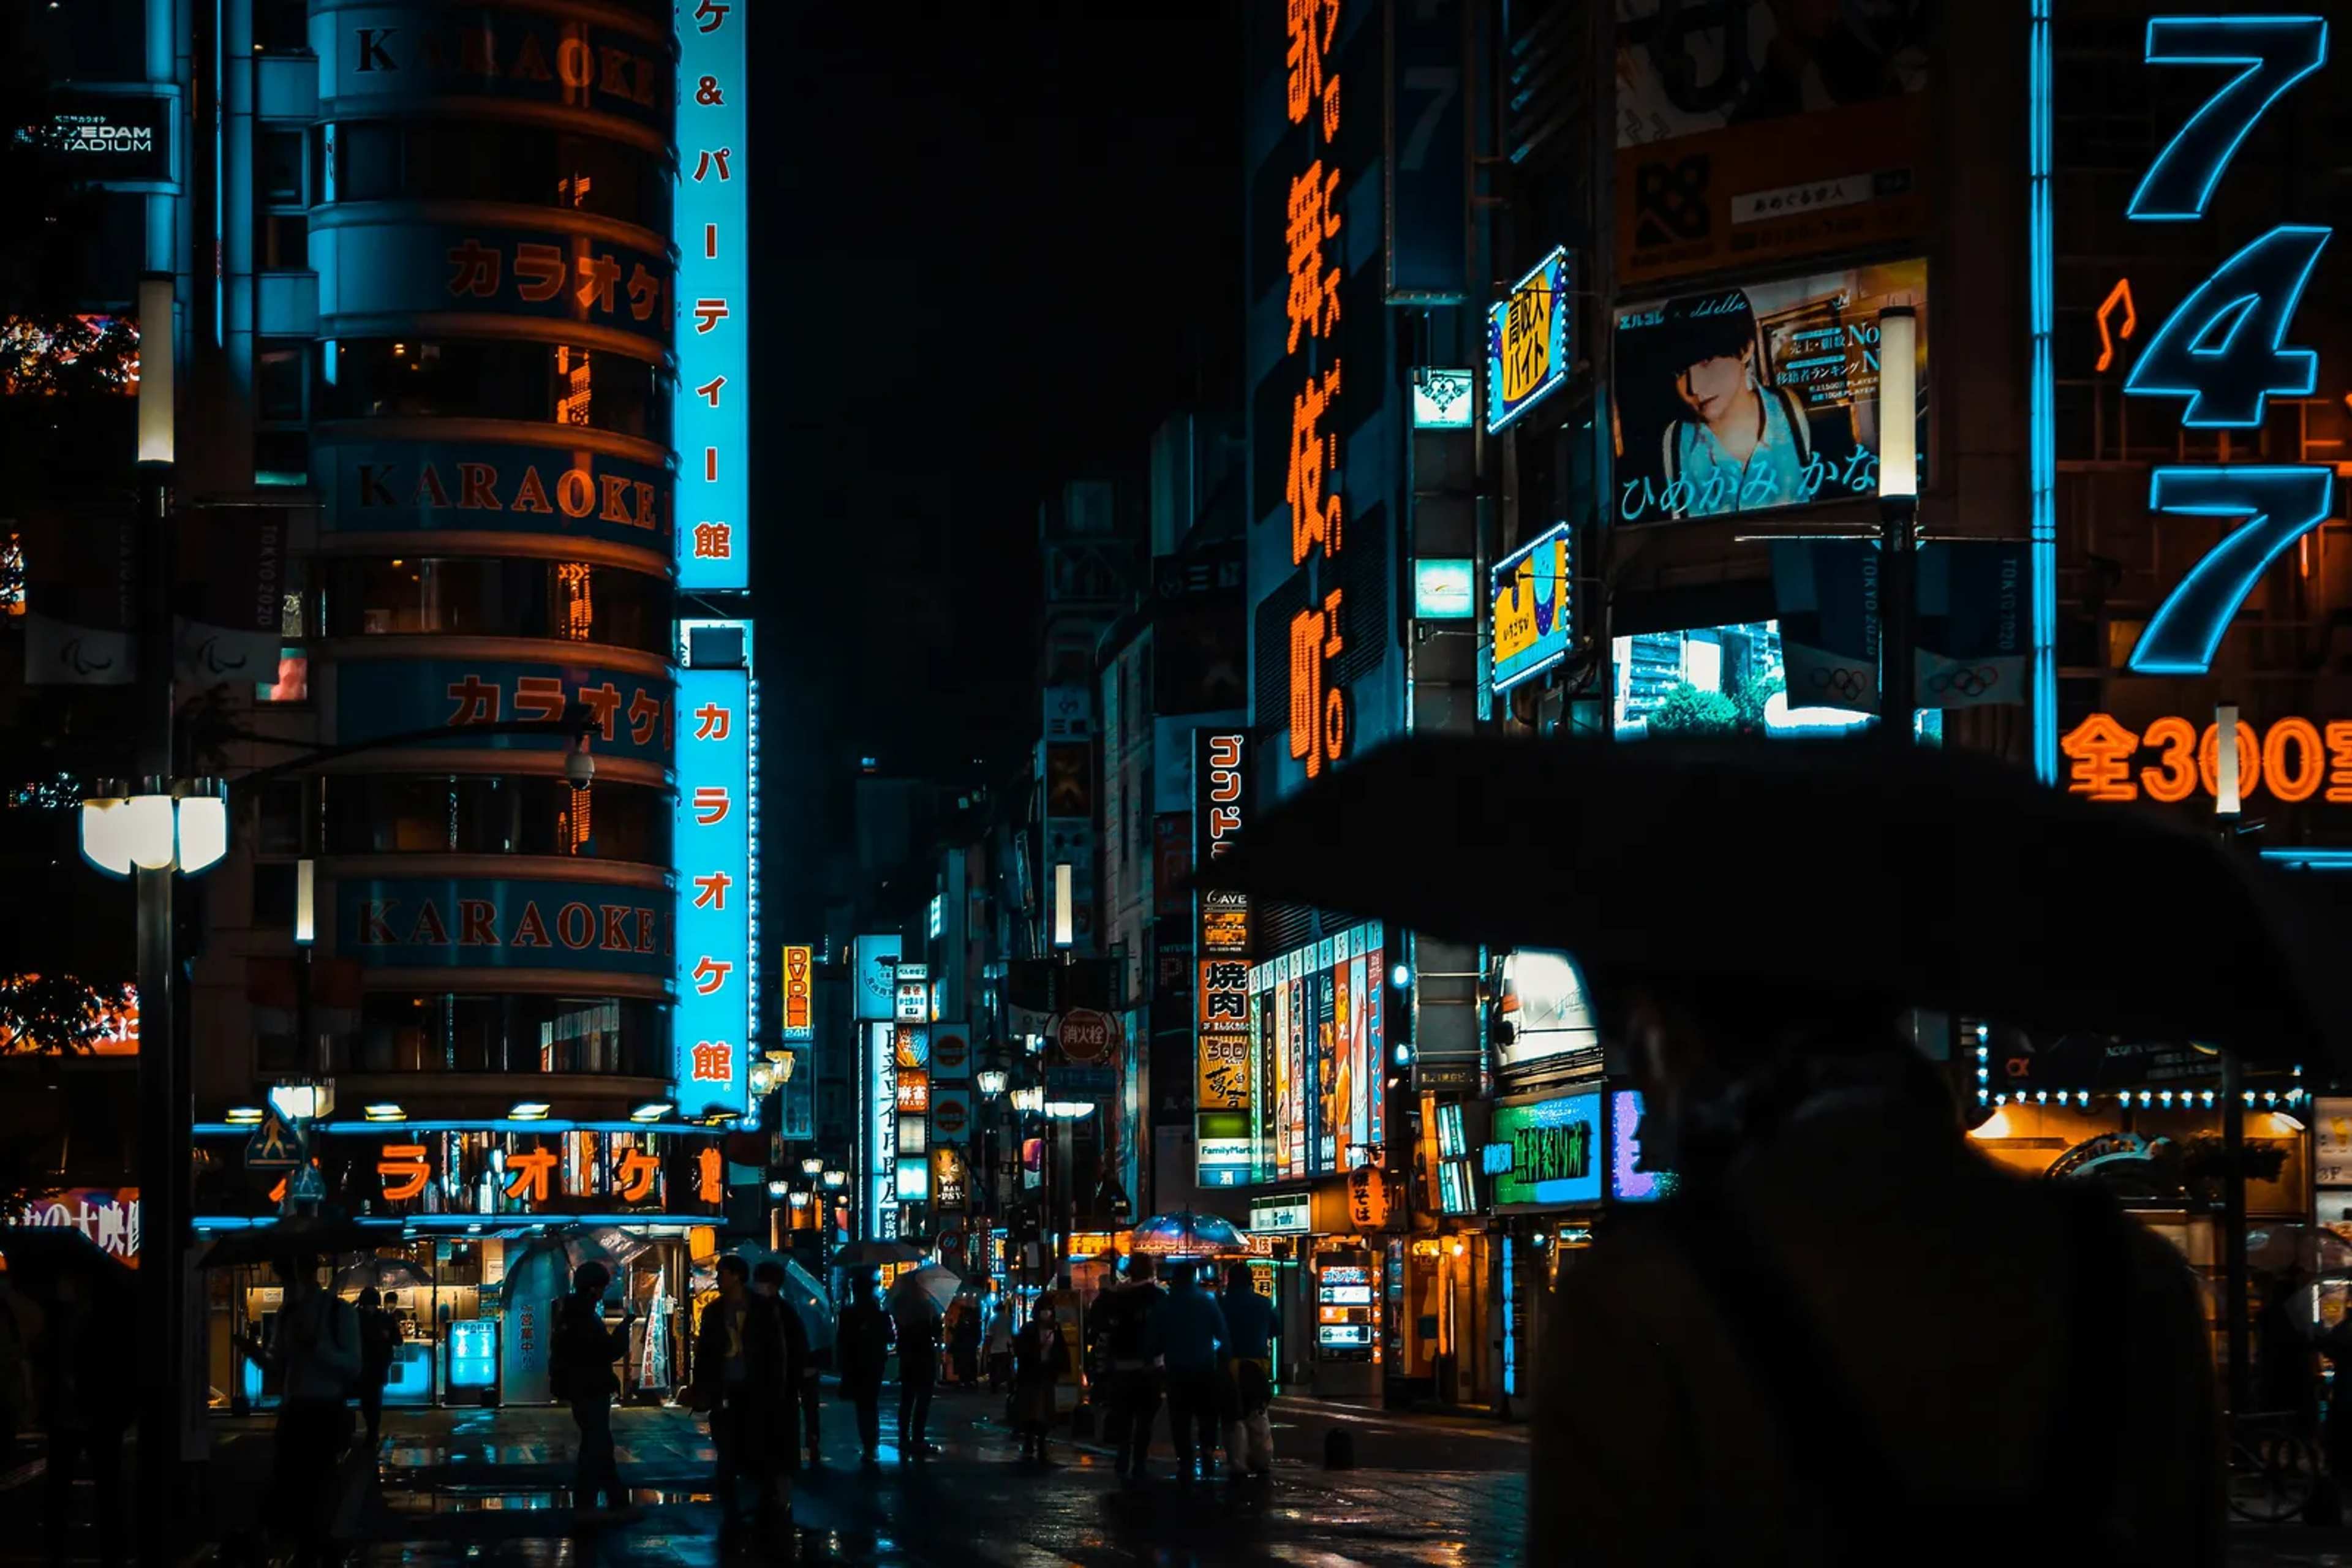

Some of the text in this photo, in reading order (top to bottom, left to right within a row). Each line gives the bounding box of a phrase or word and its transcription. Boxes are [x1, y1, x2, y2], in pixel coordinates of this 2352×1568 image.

[447, 238, 659, 321] カラオケ
[356, 461, 657, 530] KARAOKE
[447, 674, 660, 745] カラオケ
[692, 703, 732, 1082] カラオケ館
[354, 898, 656, 955] KARAOKE
[1205, 961, 1248, 1019] 焼肉
[1063, 1025, 1104, 1044] 消火栓
[1202, 1146, 1251, 1155] FamilyMart
